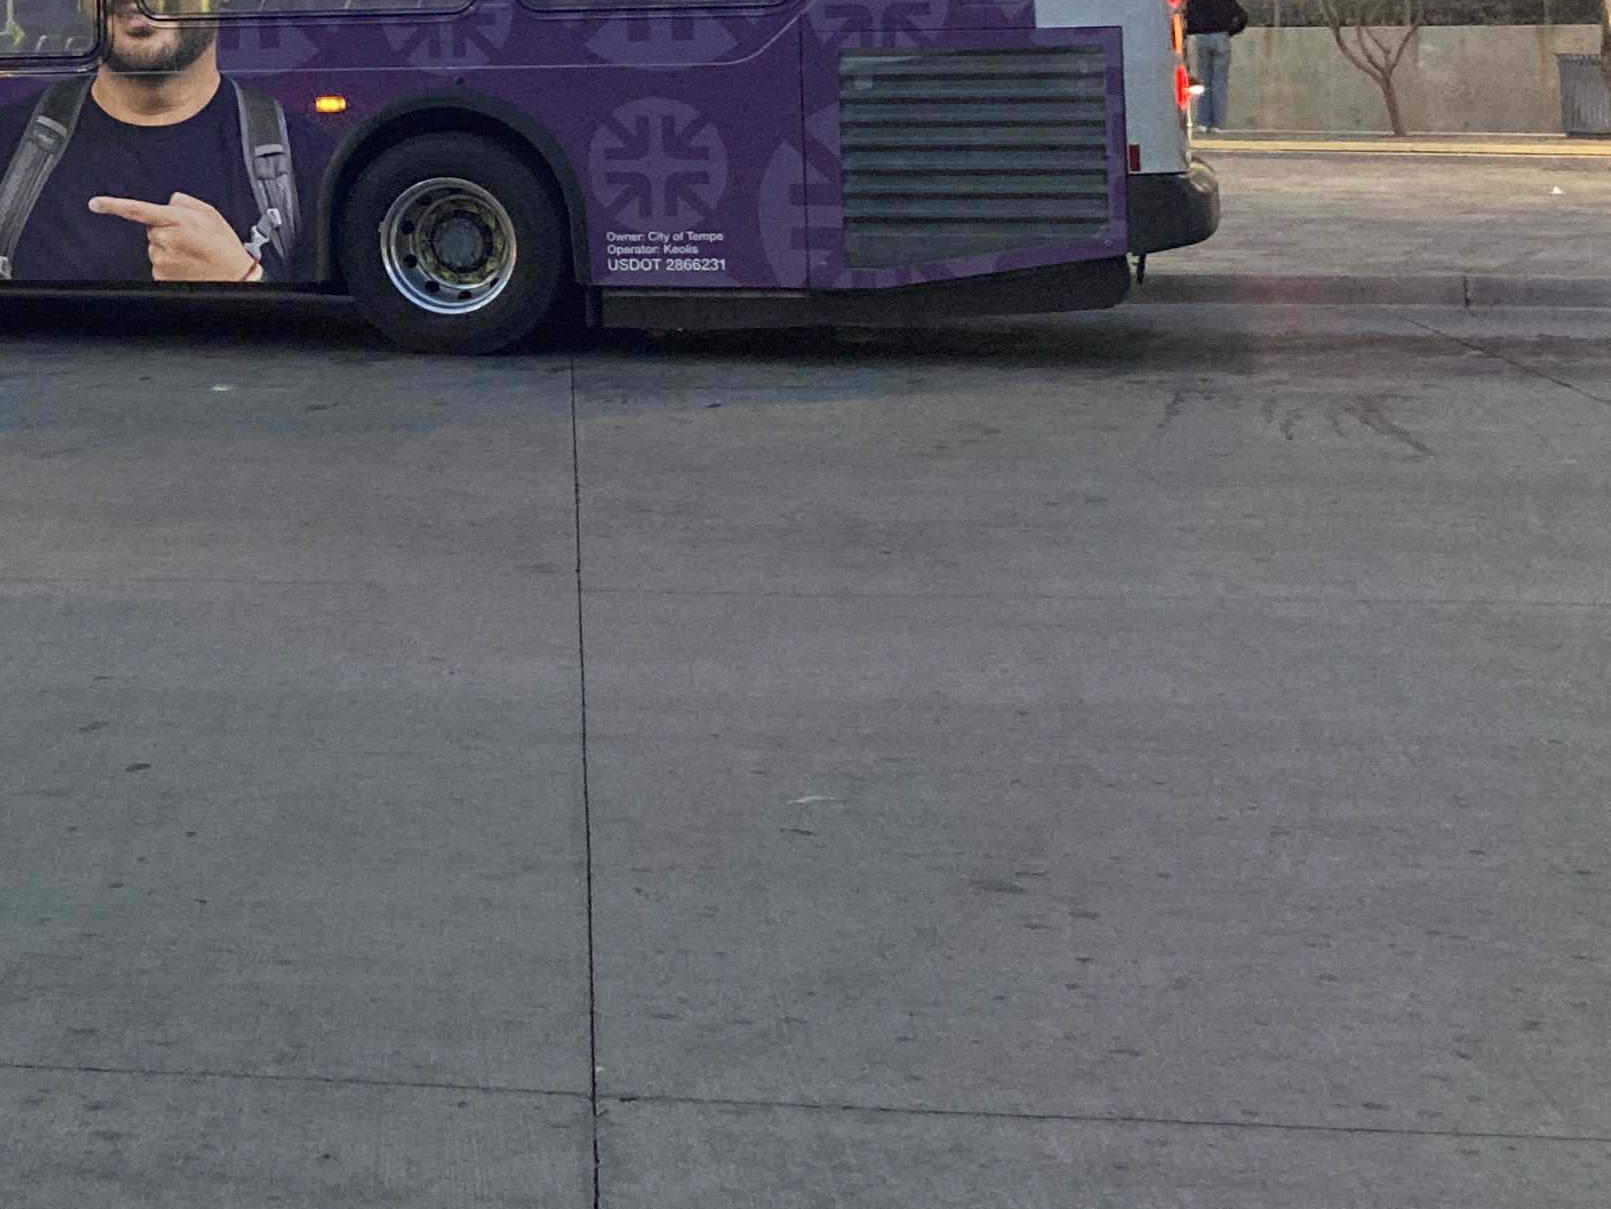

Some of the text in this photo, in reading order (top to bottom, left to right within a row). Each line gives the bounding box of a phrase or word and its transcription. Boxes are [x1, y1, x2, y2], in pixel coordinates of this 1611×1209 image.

[606, 231, 724, 242] Owner: City of Tempe
[607, 244, 699, 255] Operator: Keolis
[608, 258, 726, 271] USDOT 2866231
